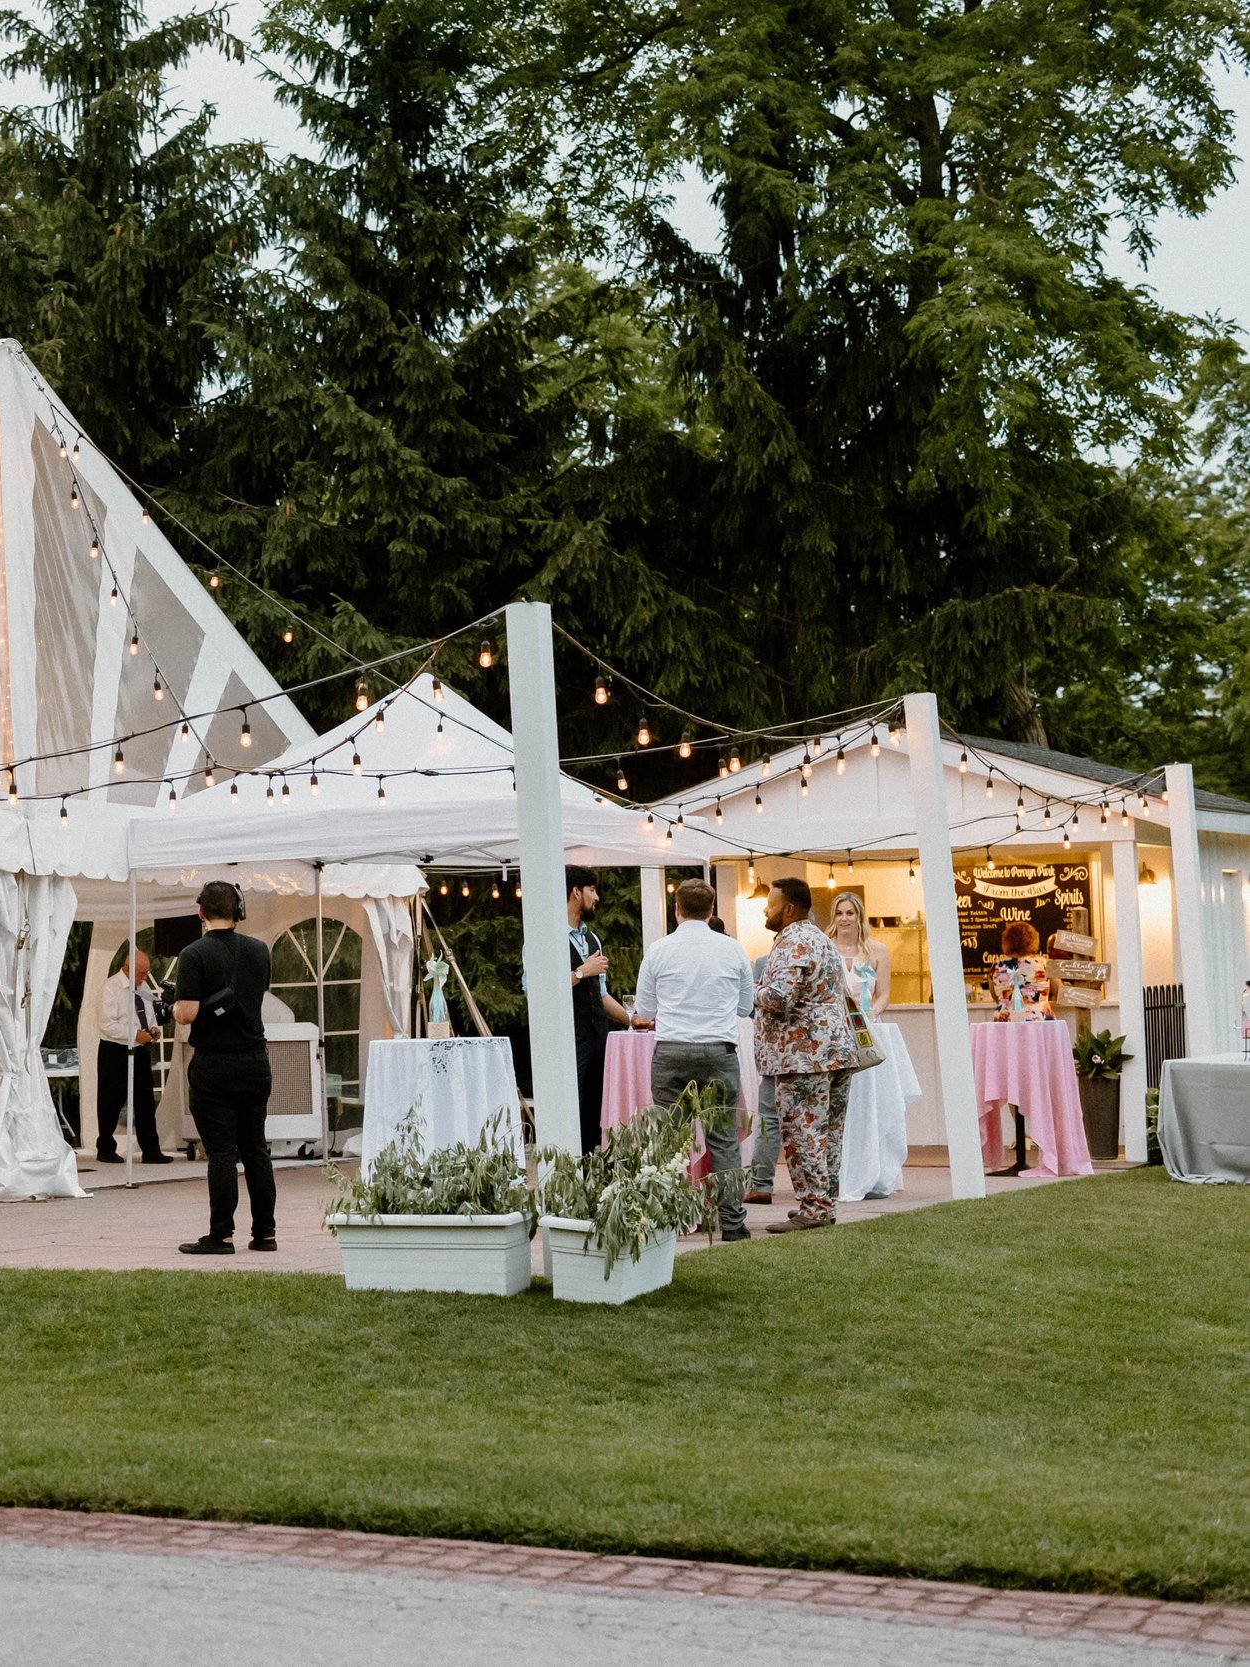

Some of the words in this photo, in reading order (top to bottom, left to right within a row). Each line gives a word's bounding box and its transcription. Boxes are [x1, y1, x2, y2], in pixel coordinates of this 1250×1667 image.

[973, 867, 1004, 879] Welcome
[1004, 866, 1011, 878] to
[1037, 865, 1055, 877] Park
[983, 885, 1009, 897] From
[1011, 888, 1025, 897] the
[1027, 885, 1048, 896] Bar
[1054, 888, 1084, 910] Spirits
[1000, 907, 1031, 921] Wine
[1059, 961, 1095, 970] Cocktails
